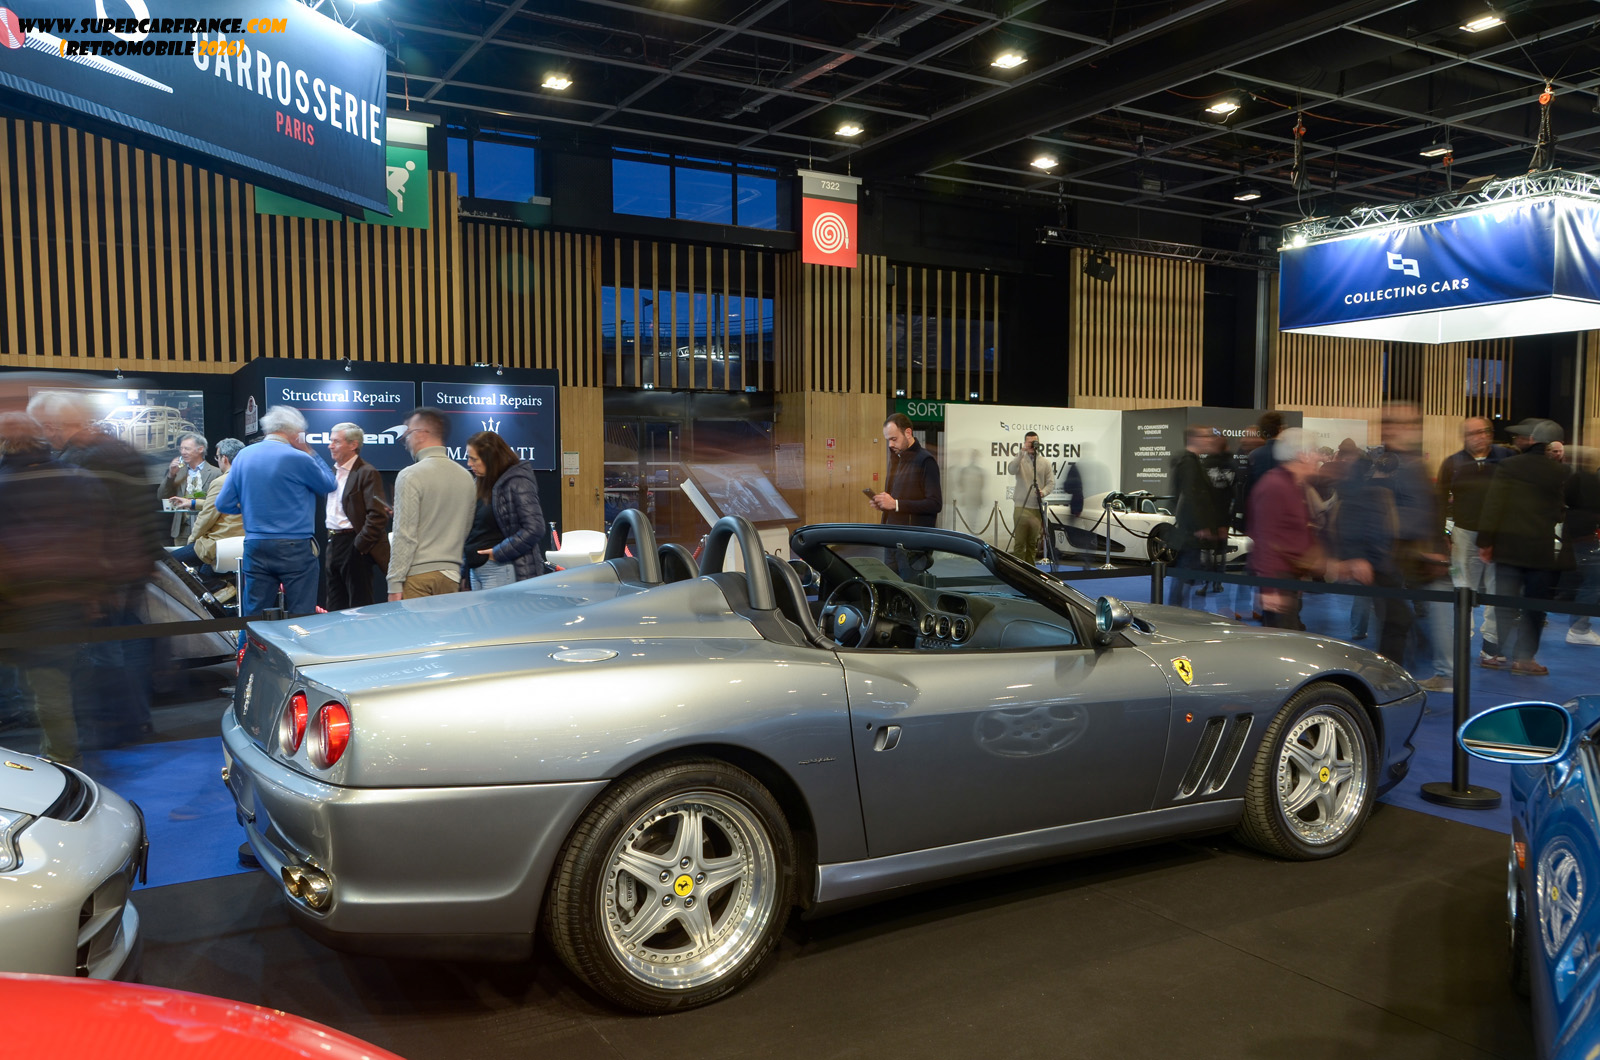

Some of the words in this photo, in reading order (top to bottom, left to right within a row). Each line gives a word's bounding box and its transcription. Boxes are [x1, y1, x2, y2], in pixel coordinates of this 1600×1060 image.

[275, 110, 315, 146] PARIS
[821, 180, 840, 191] 7322
[1344, 283, 1428, 305] COLLECTING
[1431, 277, 1470, 293] CARS
[281, 388, 349, 402] Structural
[352, 390, 401, 407] Repairs
[436, 391, 497, 406] Structural
[499, 393, 543, 410] Repairs
[1011, 423, 1055, 432] COLLECTING
[1056, 424, 1074, 432] CARS
[1063, 443, 1081, 458] EN
